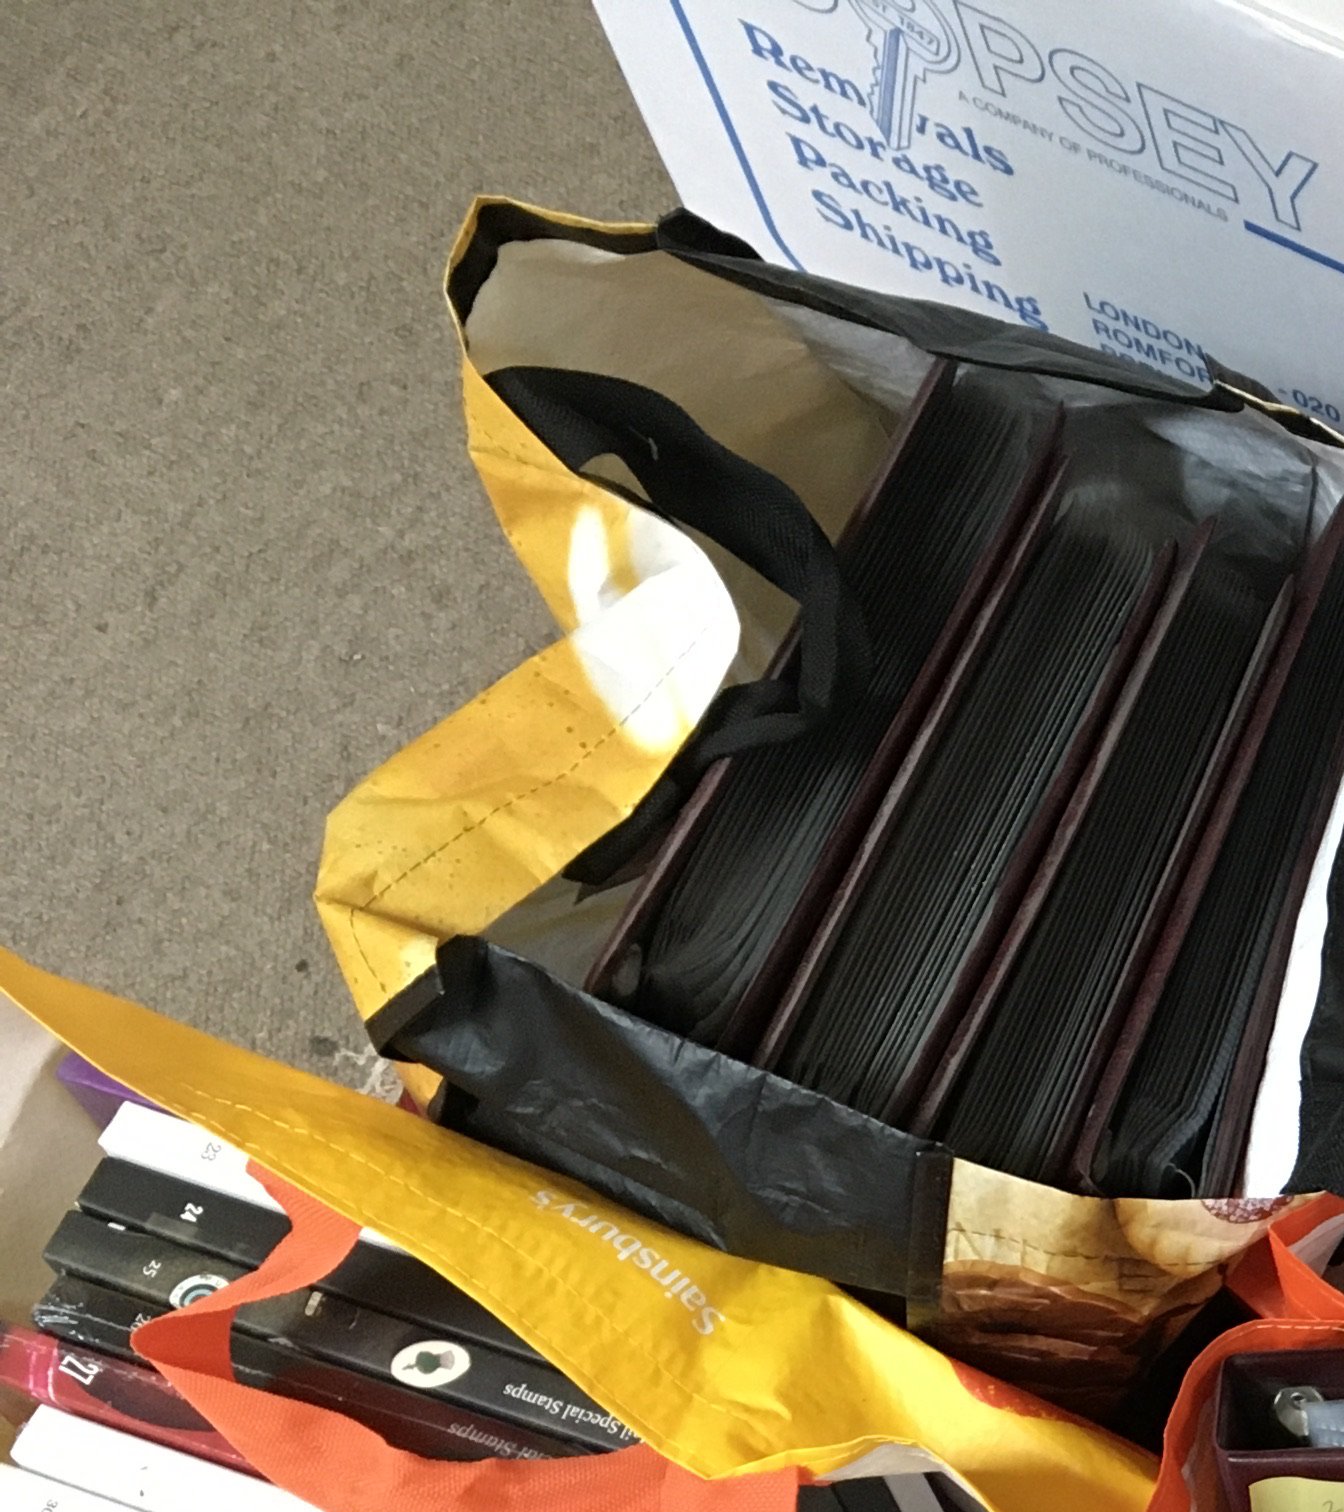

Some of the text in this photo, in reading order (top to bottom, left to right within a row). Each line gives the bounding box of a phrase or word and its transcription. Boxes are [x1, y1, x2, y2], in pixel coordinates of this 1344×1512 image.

[767, 80, 984, 208] Storage
[958, 91, 1229, 222] A COMPANY OF PROFESSIONALS
[786, 131, 1002, 266] Packing
[811, 188, 1048, 332] Shipping
[1083, 292, 1205, 360] LONDON
[1092, 318, 1213, 385] ROMFOR
[201, 1141, 222, 1162] 23
[180, 1202, 204, 1223] 24
[142, 1260, 162, 1278] 25
[531, 1189, 726, 1337] Sainsbury's
[58, 1354, 100, 1386] 27
[503, 1382, 561, 1416] Stamps
[562, 1402, 622, 1437] Special
